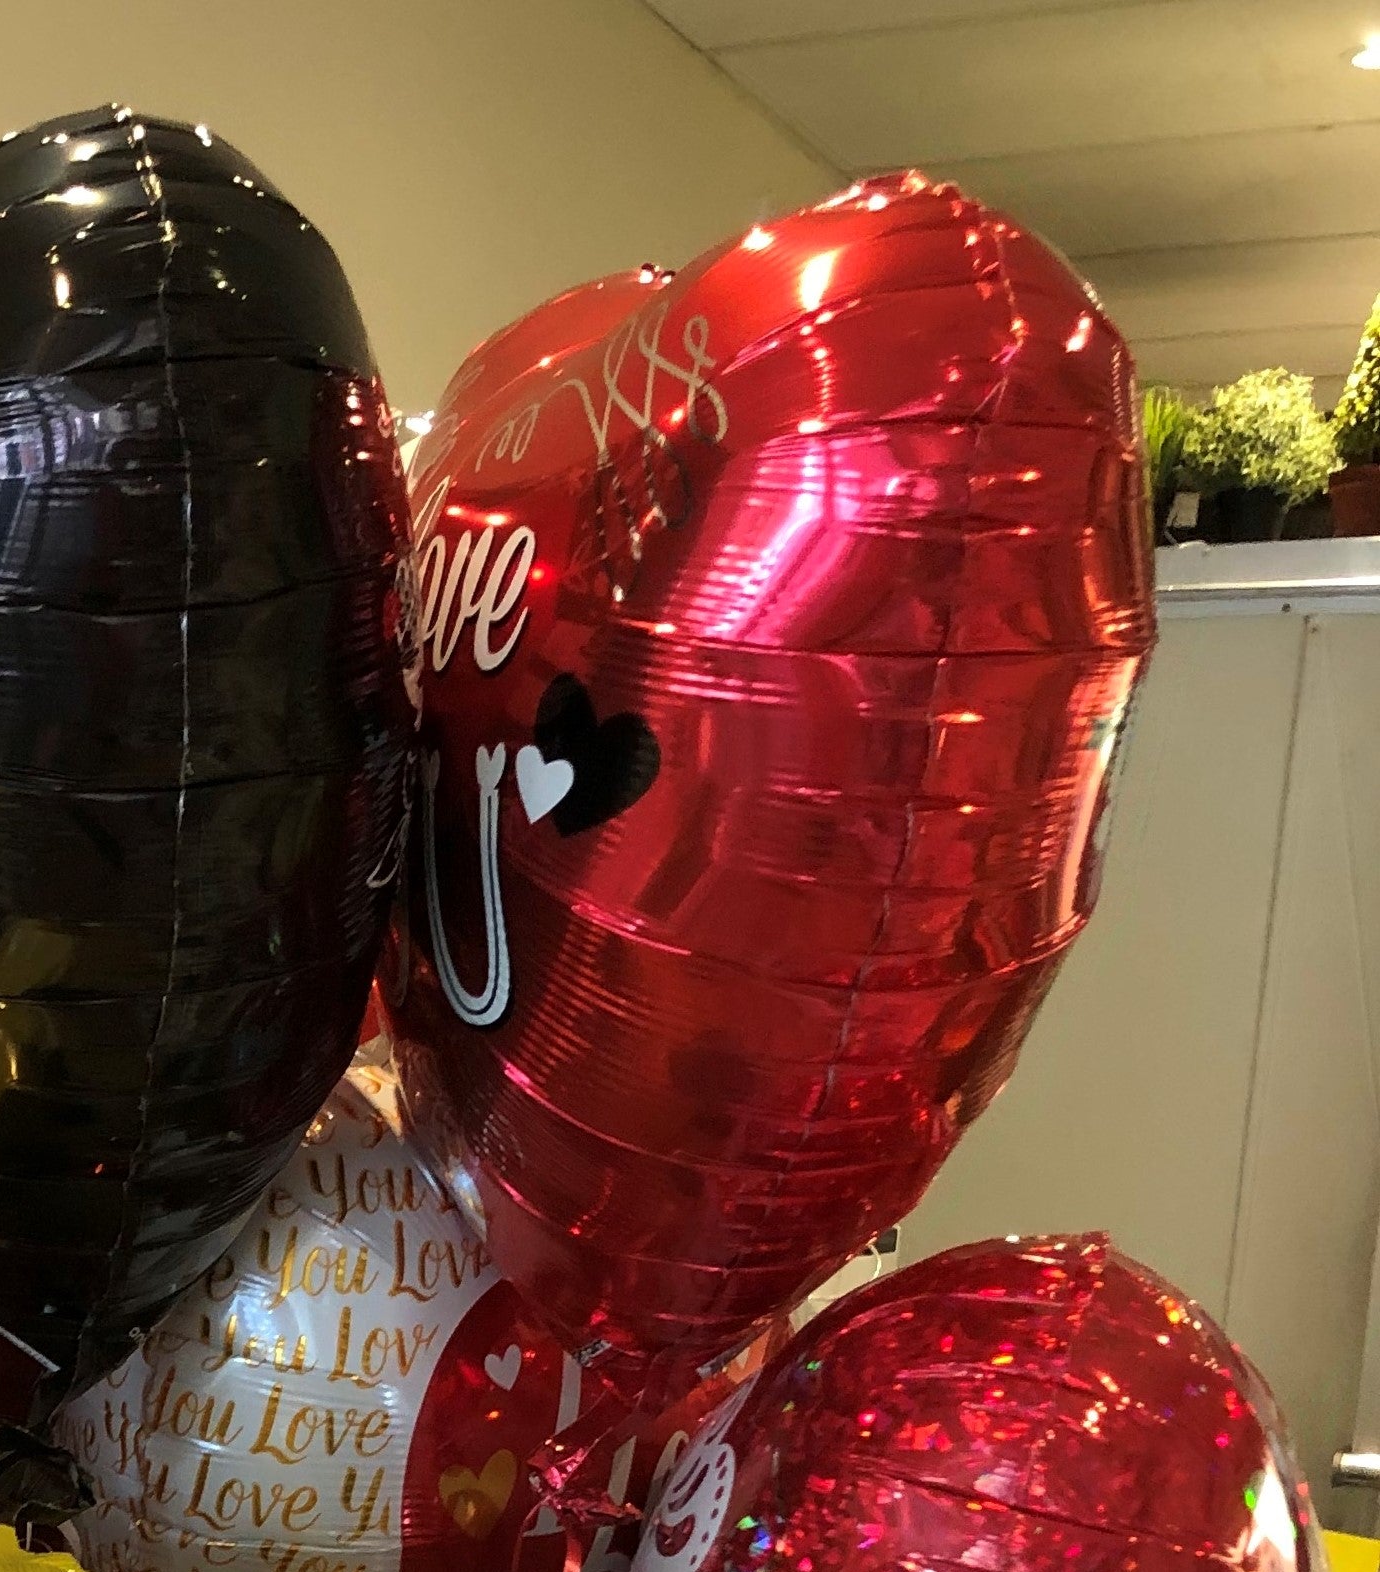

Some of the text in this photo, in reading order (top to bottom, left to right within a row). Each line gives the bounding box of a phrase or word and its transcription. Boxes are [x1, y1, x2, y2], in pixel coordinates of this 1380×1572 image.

[256, 1225, 381, 1315] You
[327, 1305, 441, 1390] Lov
[249, 1381, 394, 1466] Love
[182, 1452, 322, 1533] Love
